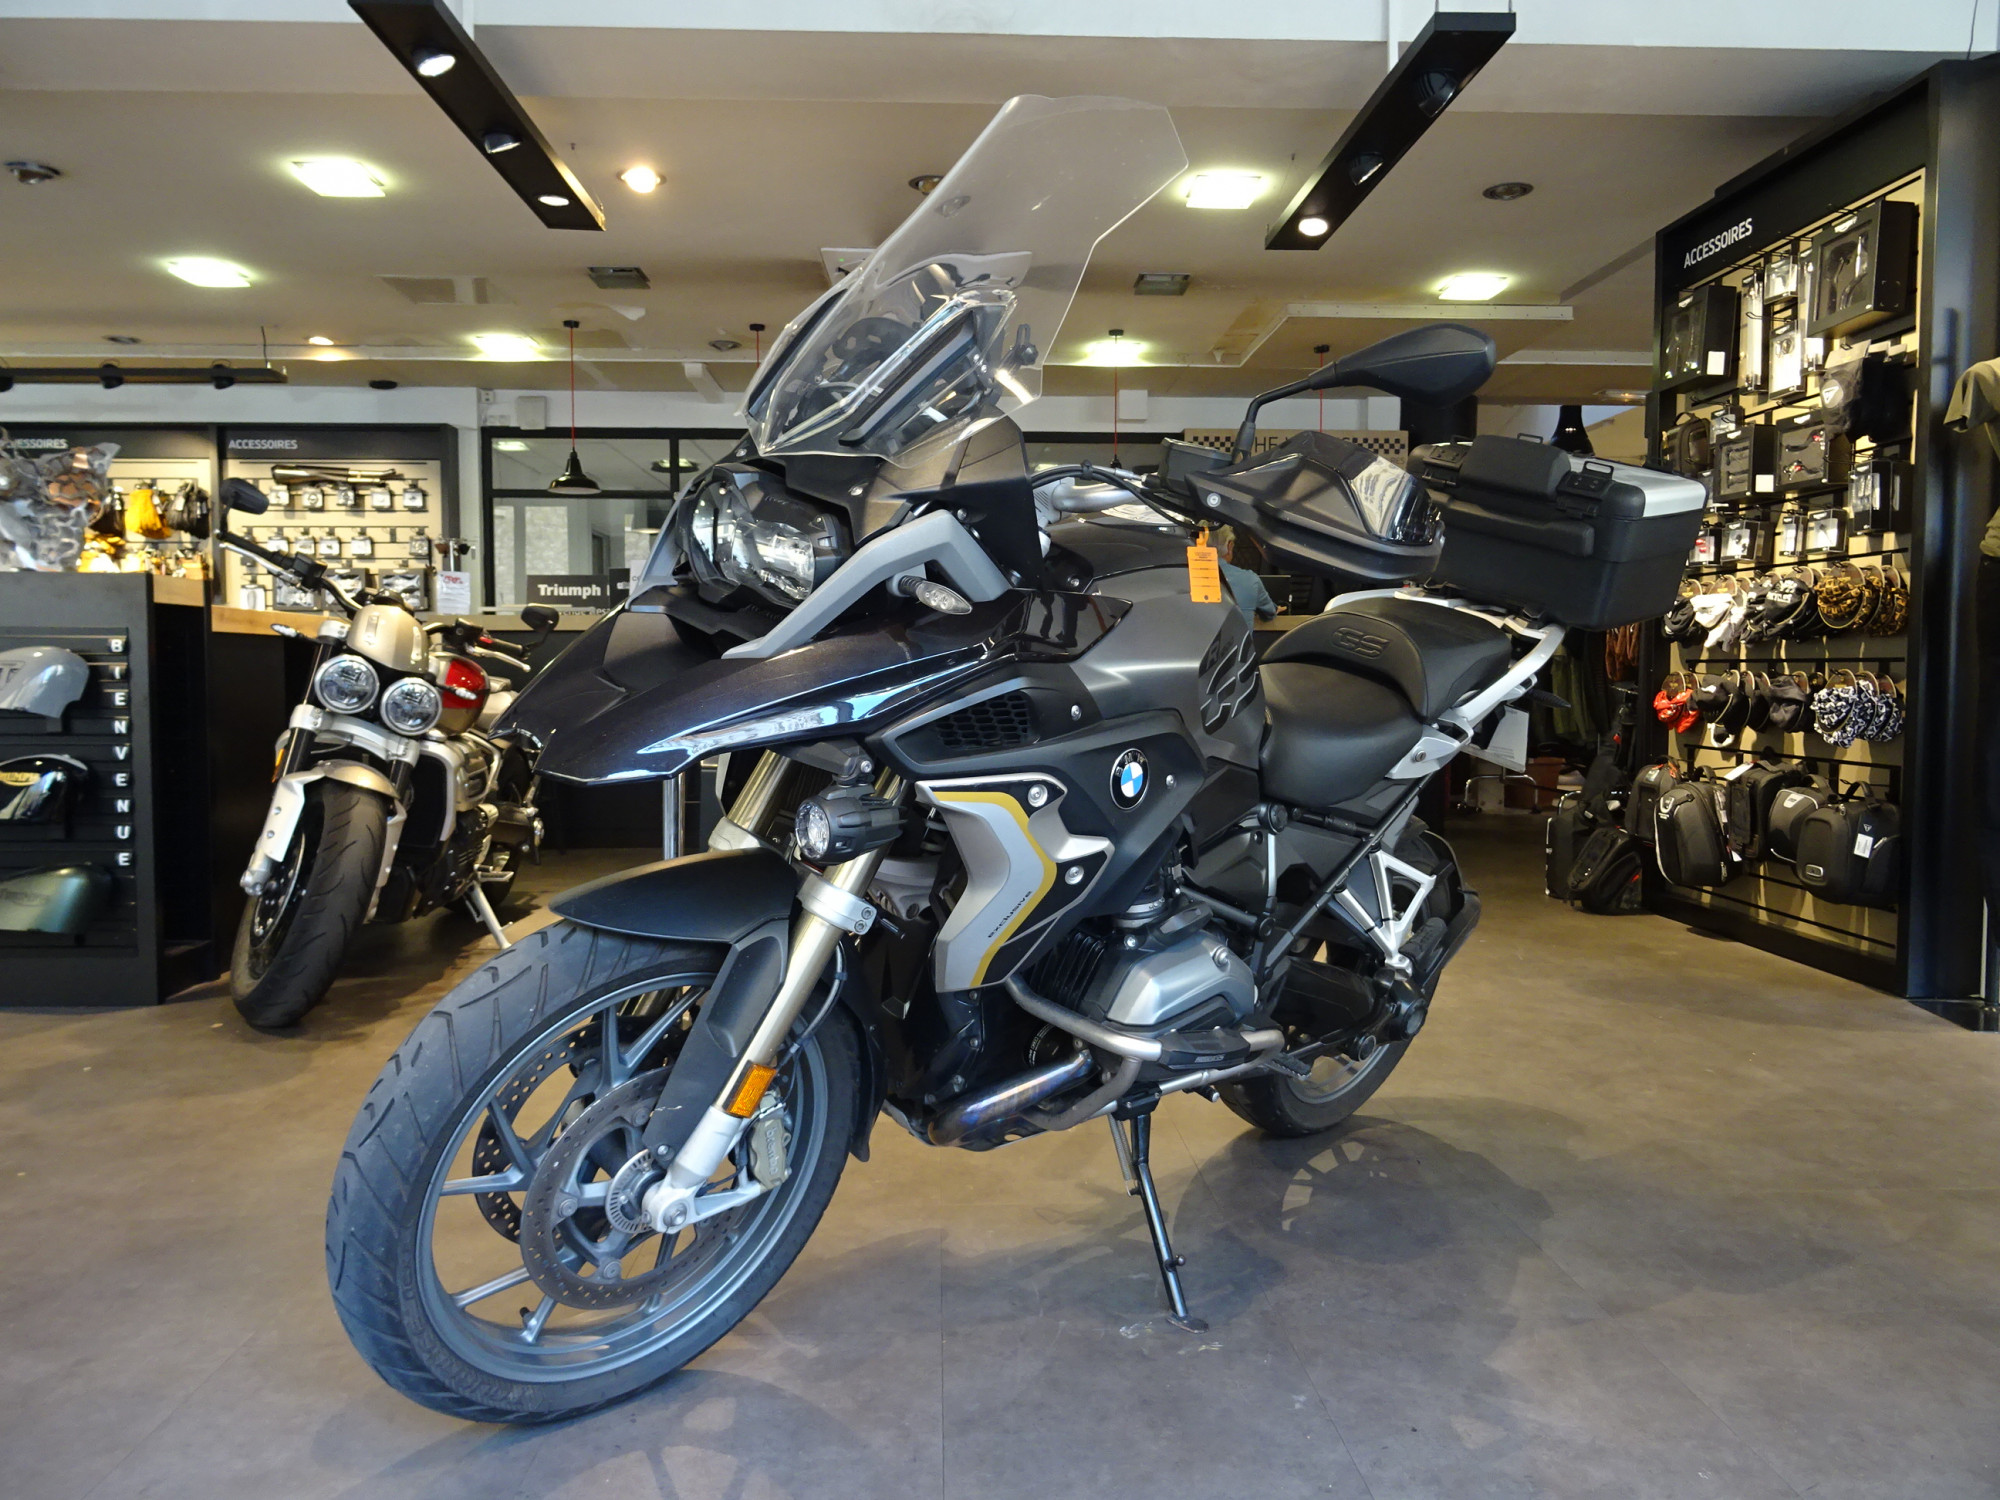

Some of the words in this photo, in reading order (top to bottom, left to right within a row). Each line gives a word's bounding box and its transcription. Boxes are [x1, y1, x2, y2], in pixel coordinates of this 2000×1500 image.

[1683, 217, 1753, 269] ACCESSOIRES
[228, 438, 298, 450] ACCESSOIRES
[537, 584, 601, 600] Triumph
